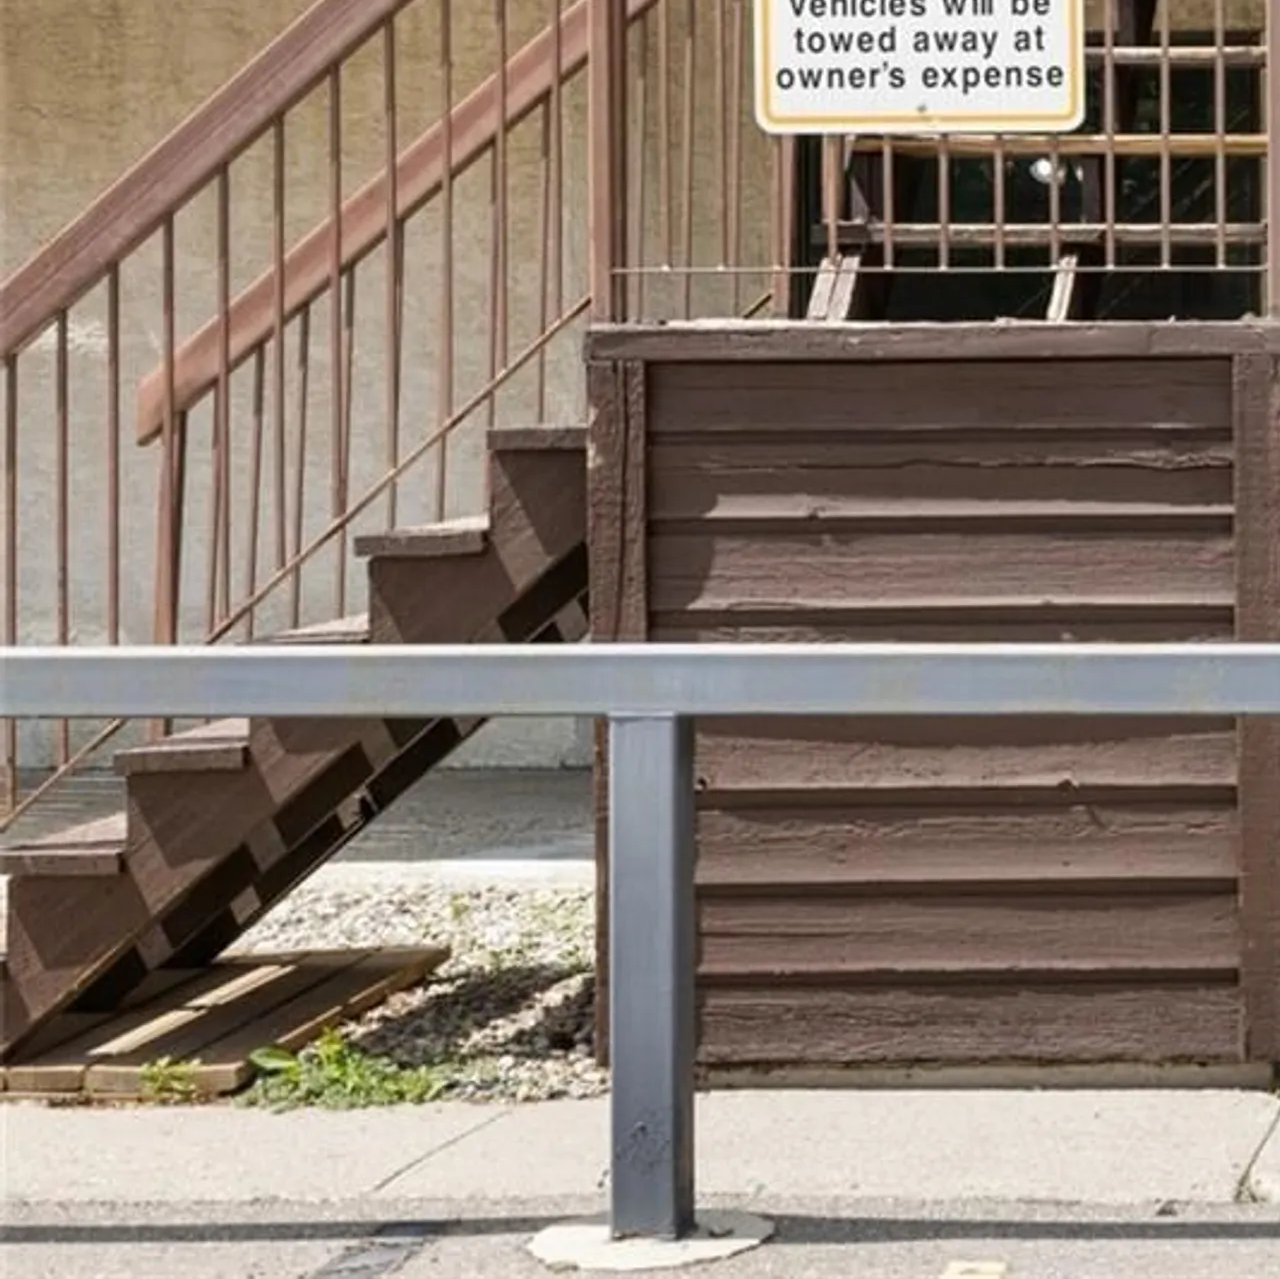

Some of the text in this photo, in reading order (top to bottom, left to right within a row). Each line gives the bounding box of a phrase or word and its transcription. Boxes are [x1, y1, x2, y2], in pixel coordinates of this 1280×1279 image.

[794, 26, 1046, 59] towed away at
[776, 61, 1065, 95] owner's expense
